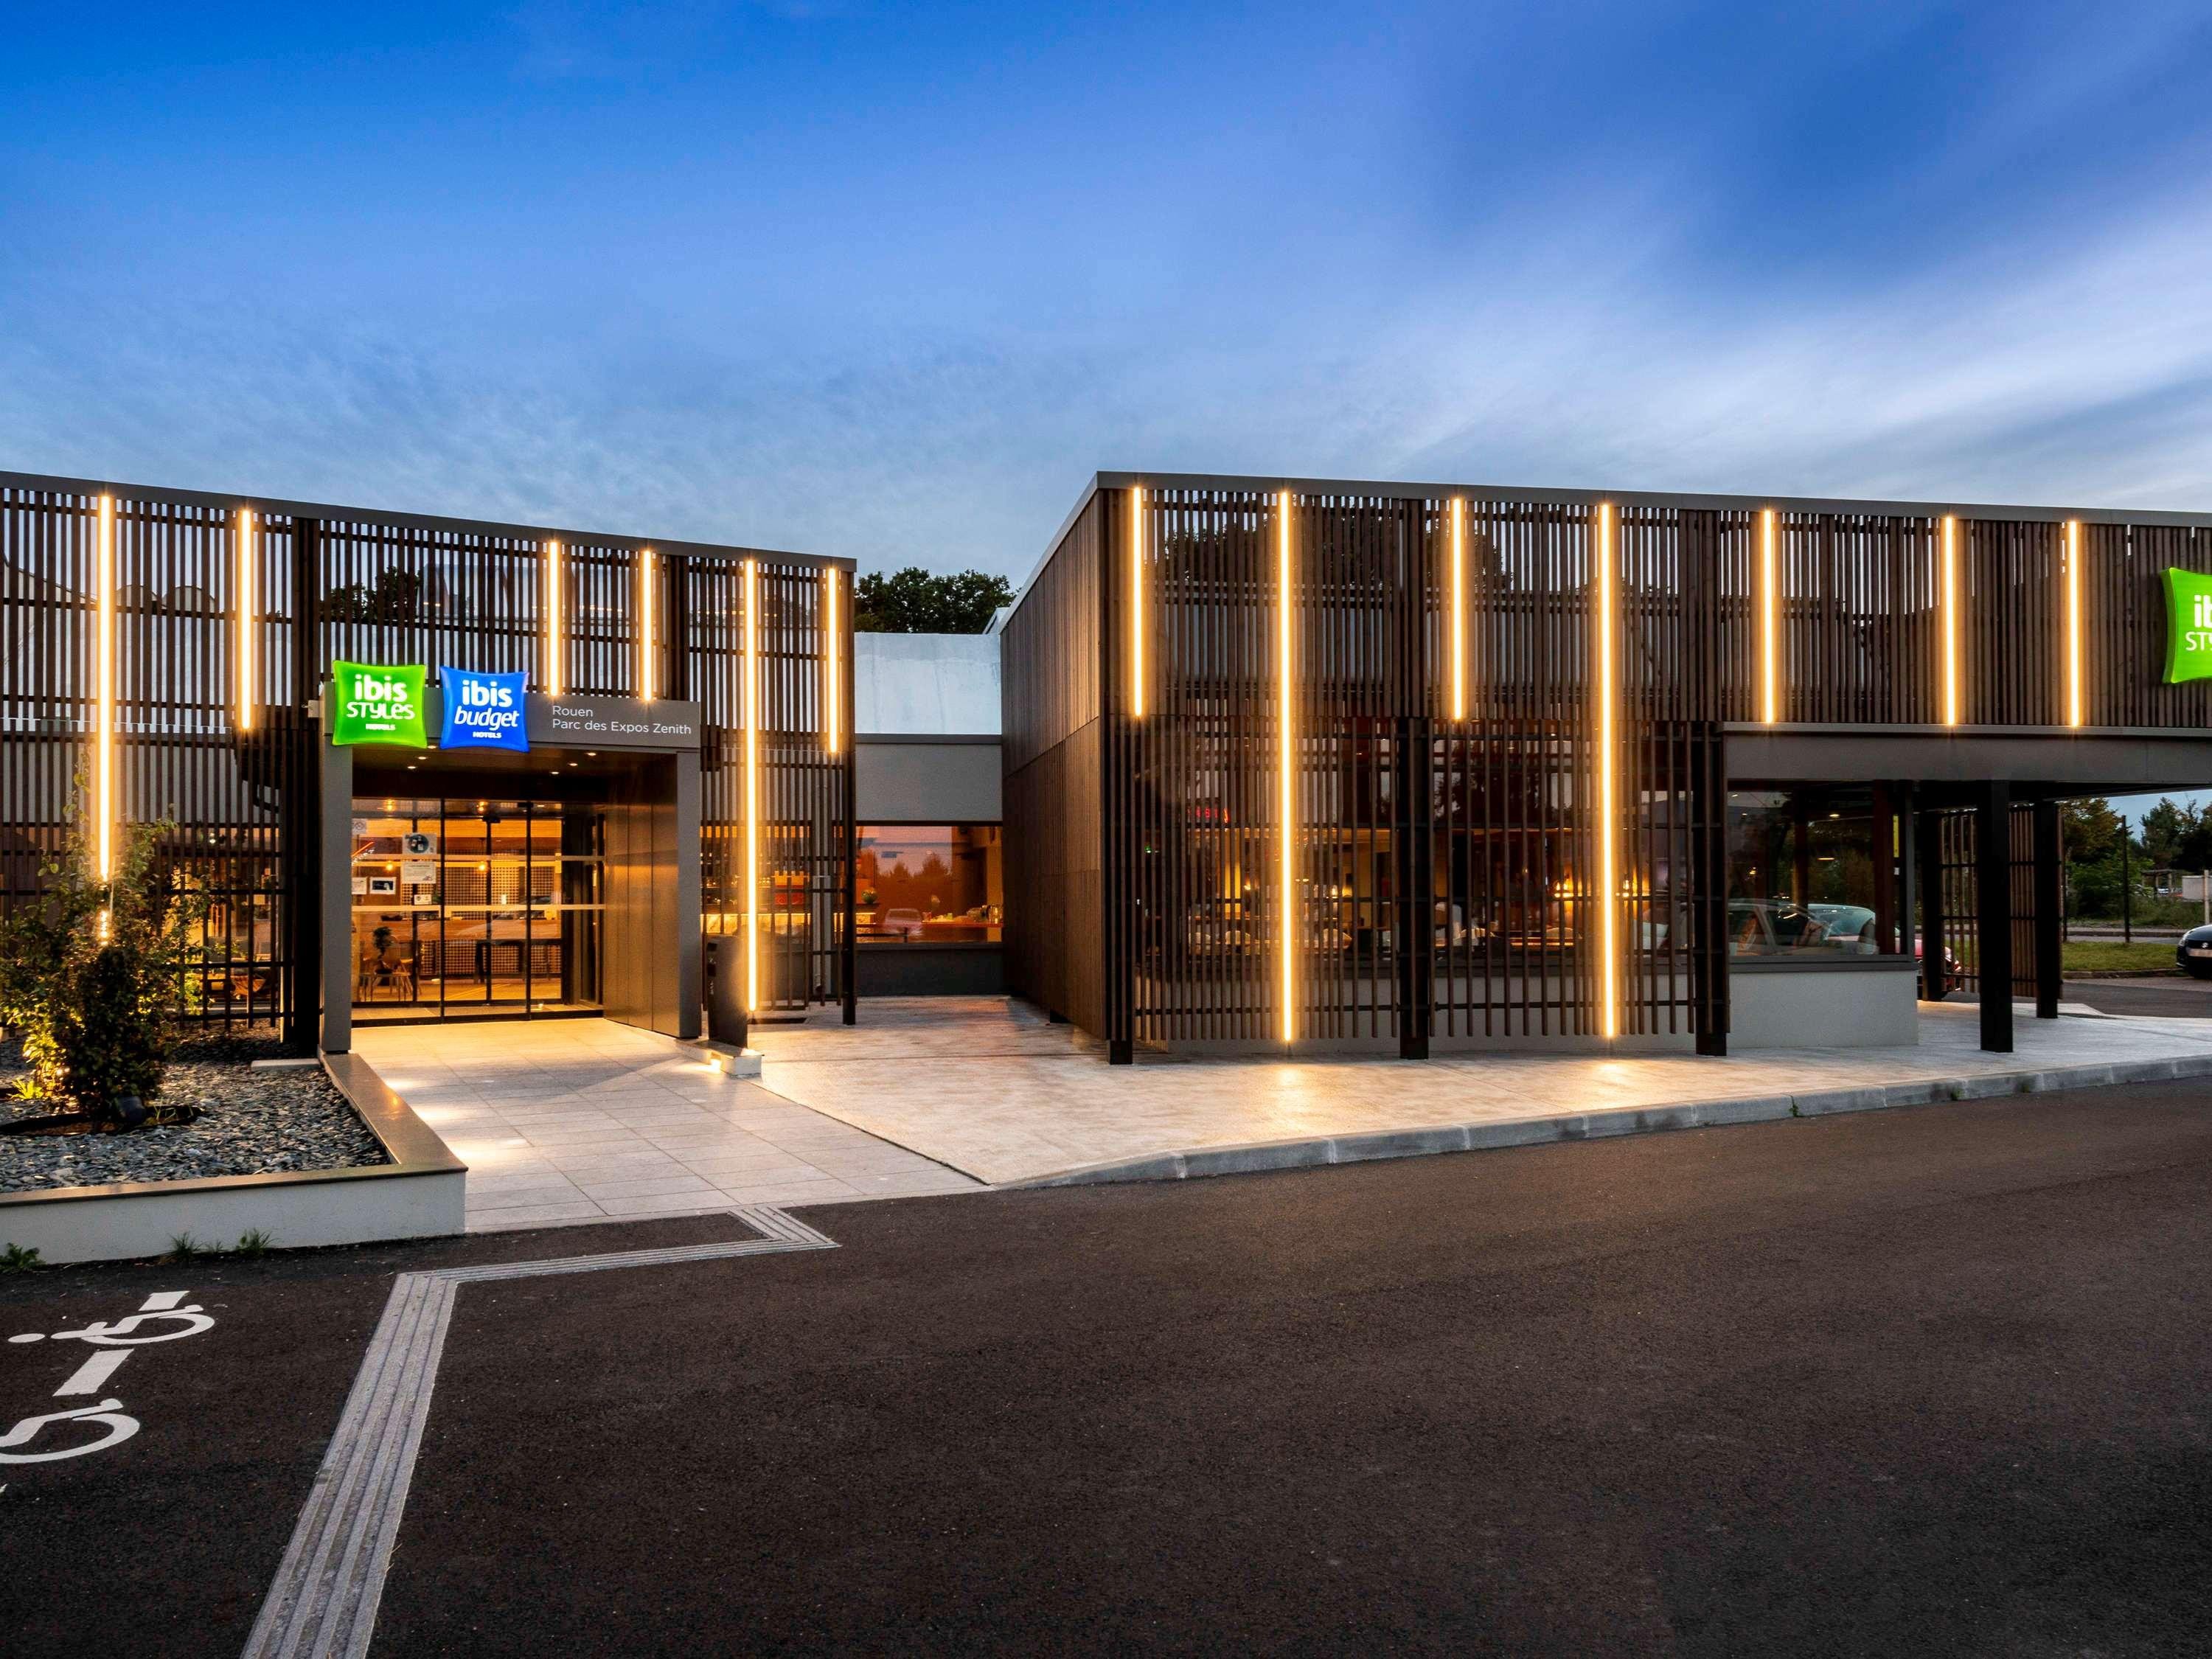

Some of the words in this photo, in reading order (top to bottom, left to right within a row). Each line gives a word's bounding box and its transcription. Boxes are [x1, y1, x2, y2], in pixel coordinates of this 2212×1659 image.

[355, 674, 408, 702] ibis
[462, 679, 513, 708] ibis
[454, 706, 520, 731] budget
[553, 706, 593, 717] Rouen
[553, 719, 581, 730] Parc
[584, 721, 607, 731] des
[611, 722, 649, 734] Expos
[653, 723, 692, 734] Zenith
